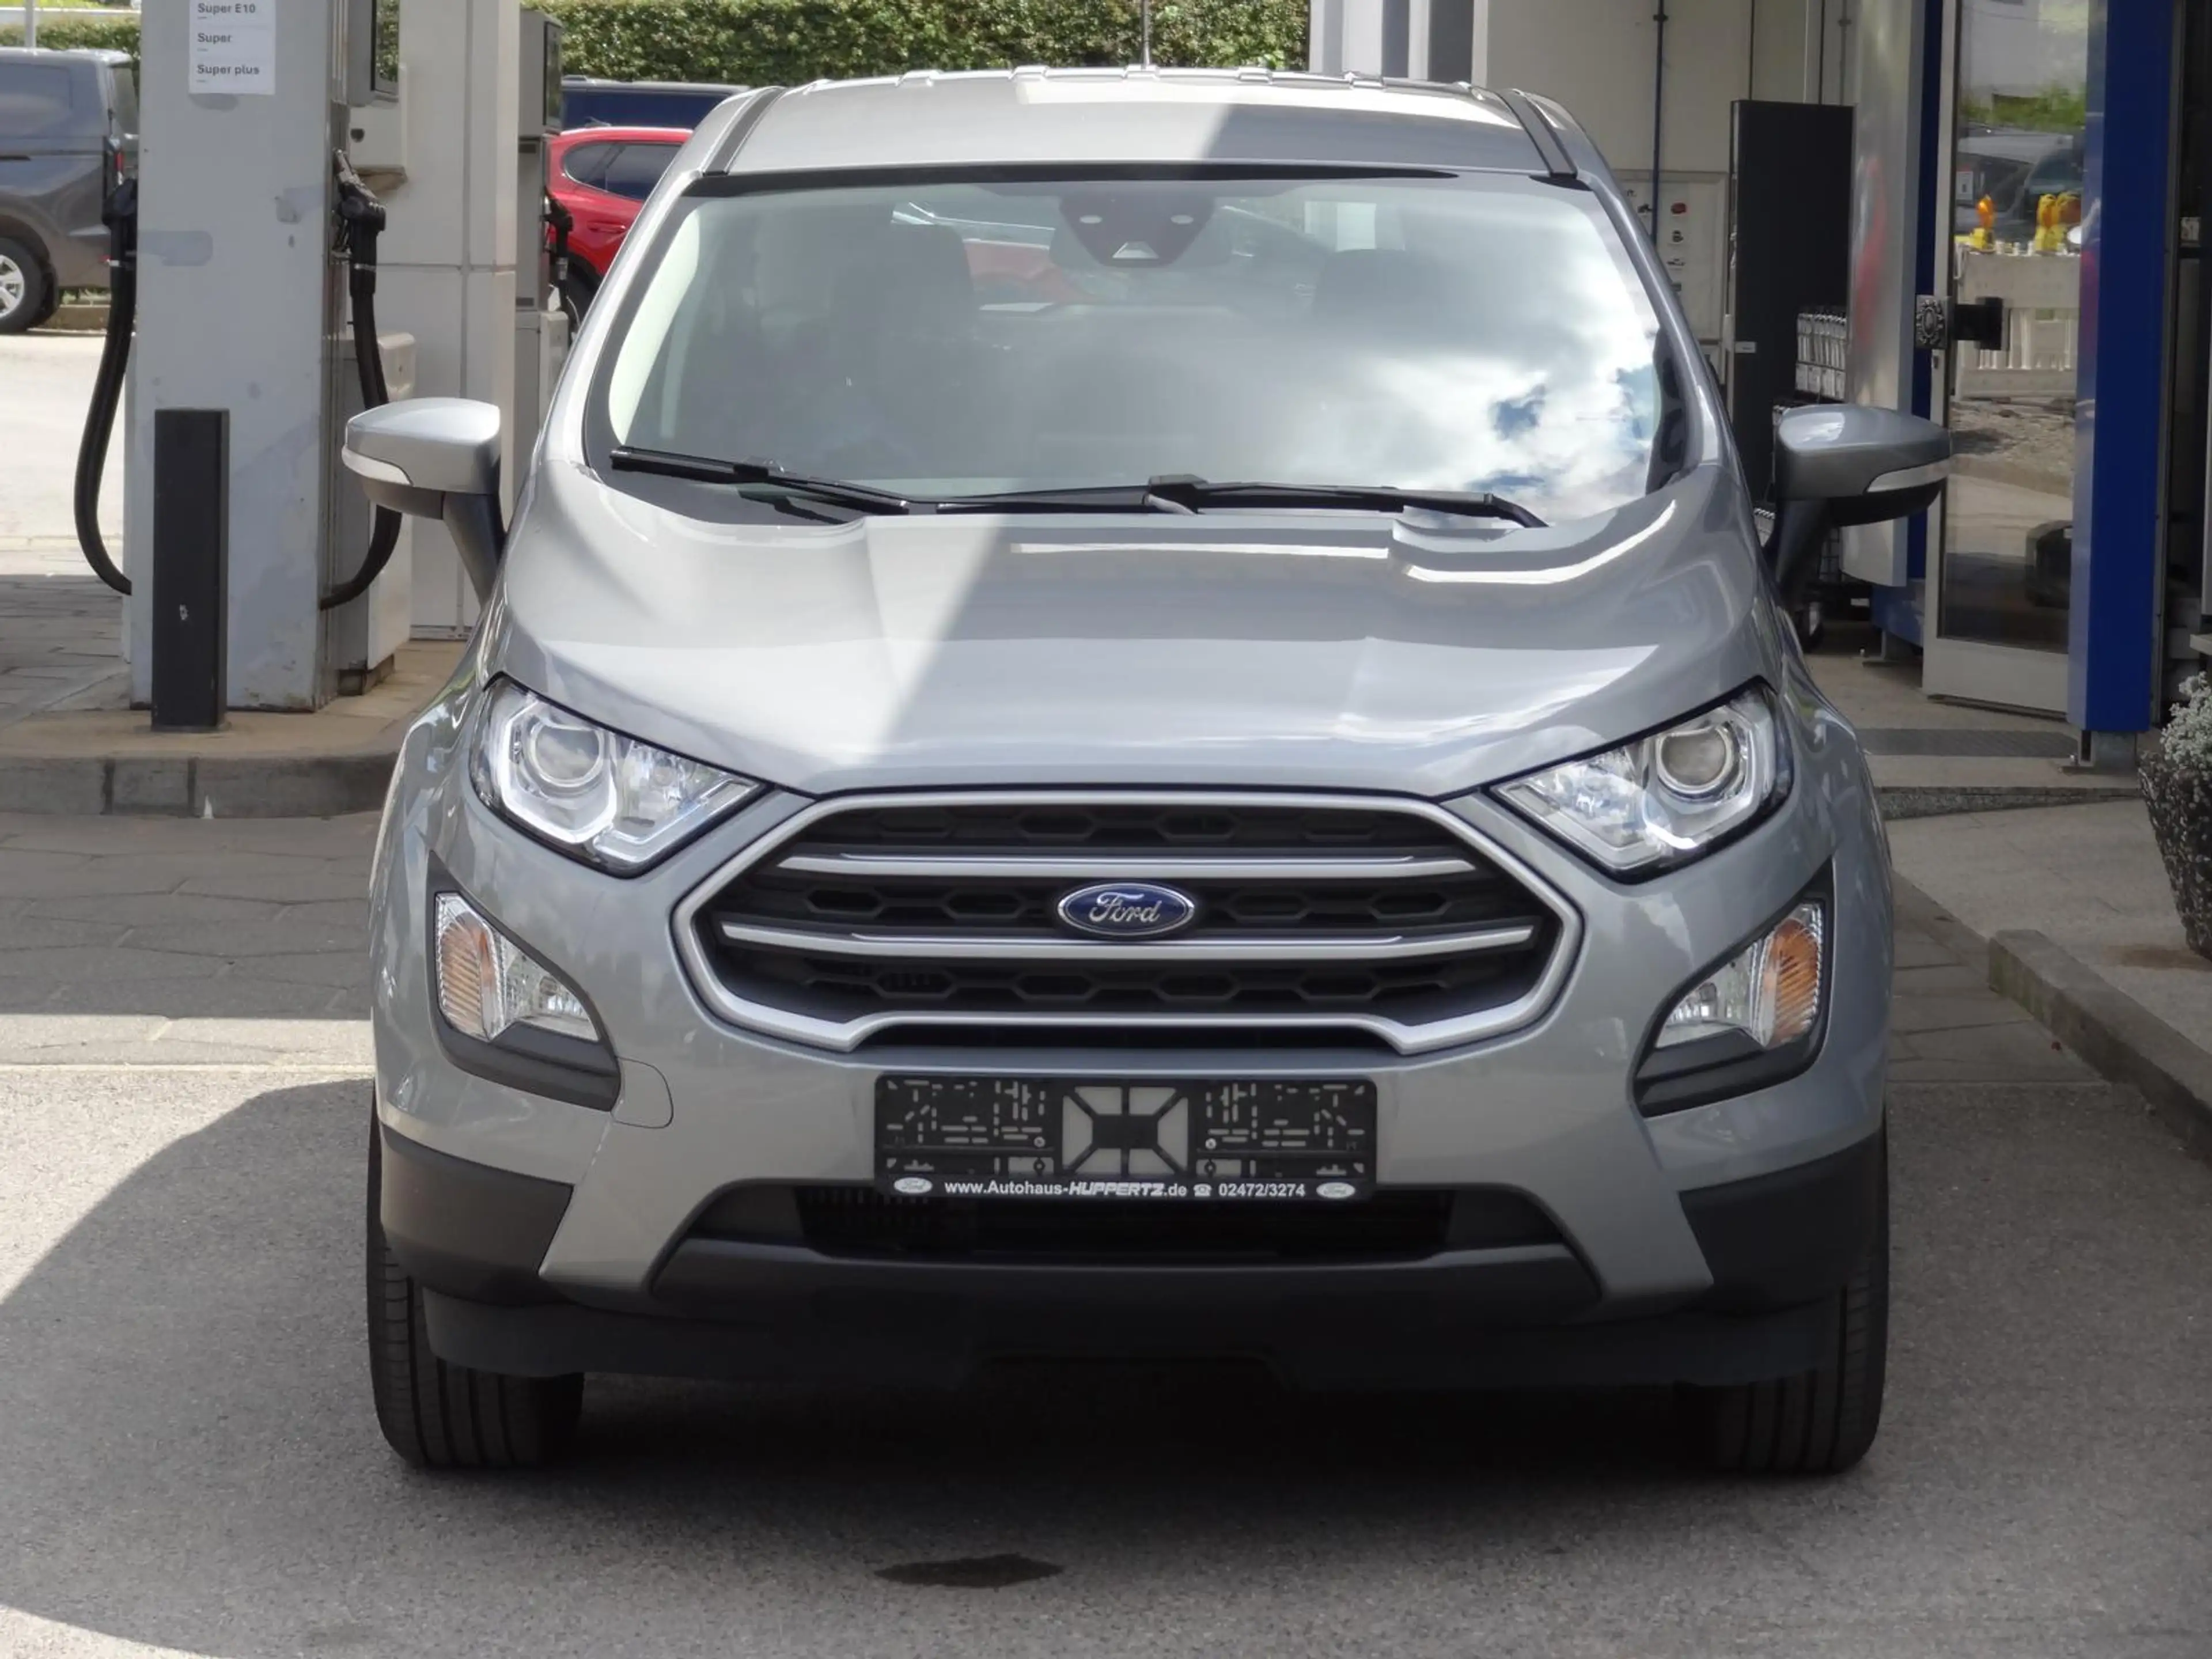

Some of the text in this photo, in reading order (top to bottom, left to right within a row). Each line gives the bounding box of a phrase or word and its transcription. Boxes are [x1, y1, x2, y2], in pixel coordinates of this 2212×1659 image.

[197, 3, 256, 15] Super E10
[197, 32, 232, 44] Super
[196, 64, 260, 76] Super plus
[1089, 891, 1162, 922] Ford
[945, 1180, 1187, 1196] www.Autohaus-HUPPERTZ.de
[1218, 1183, 1305, 1197] 02472/3274
